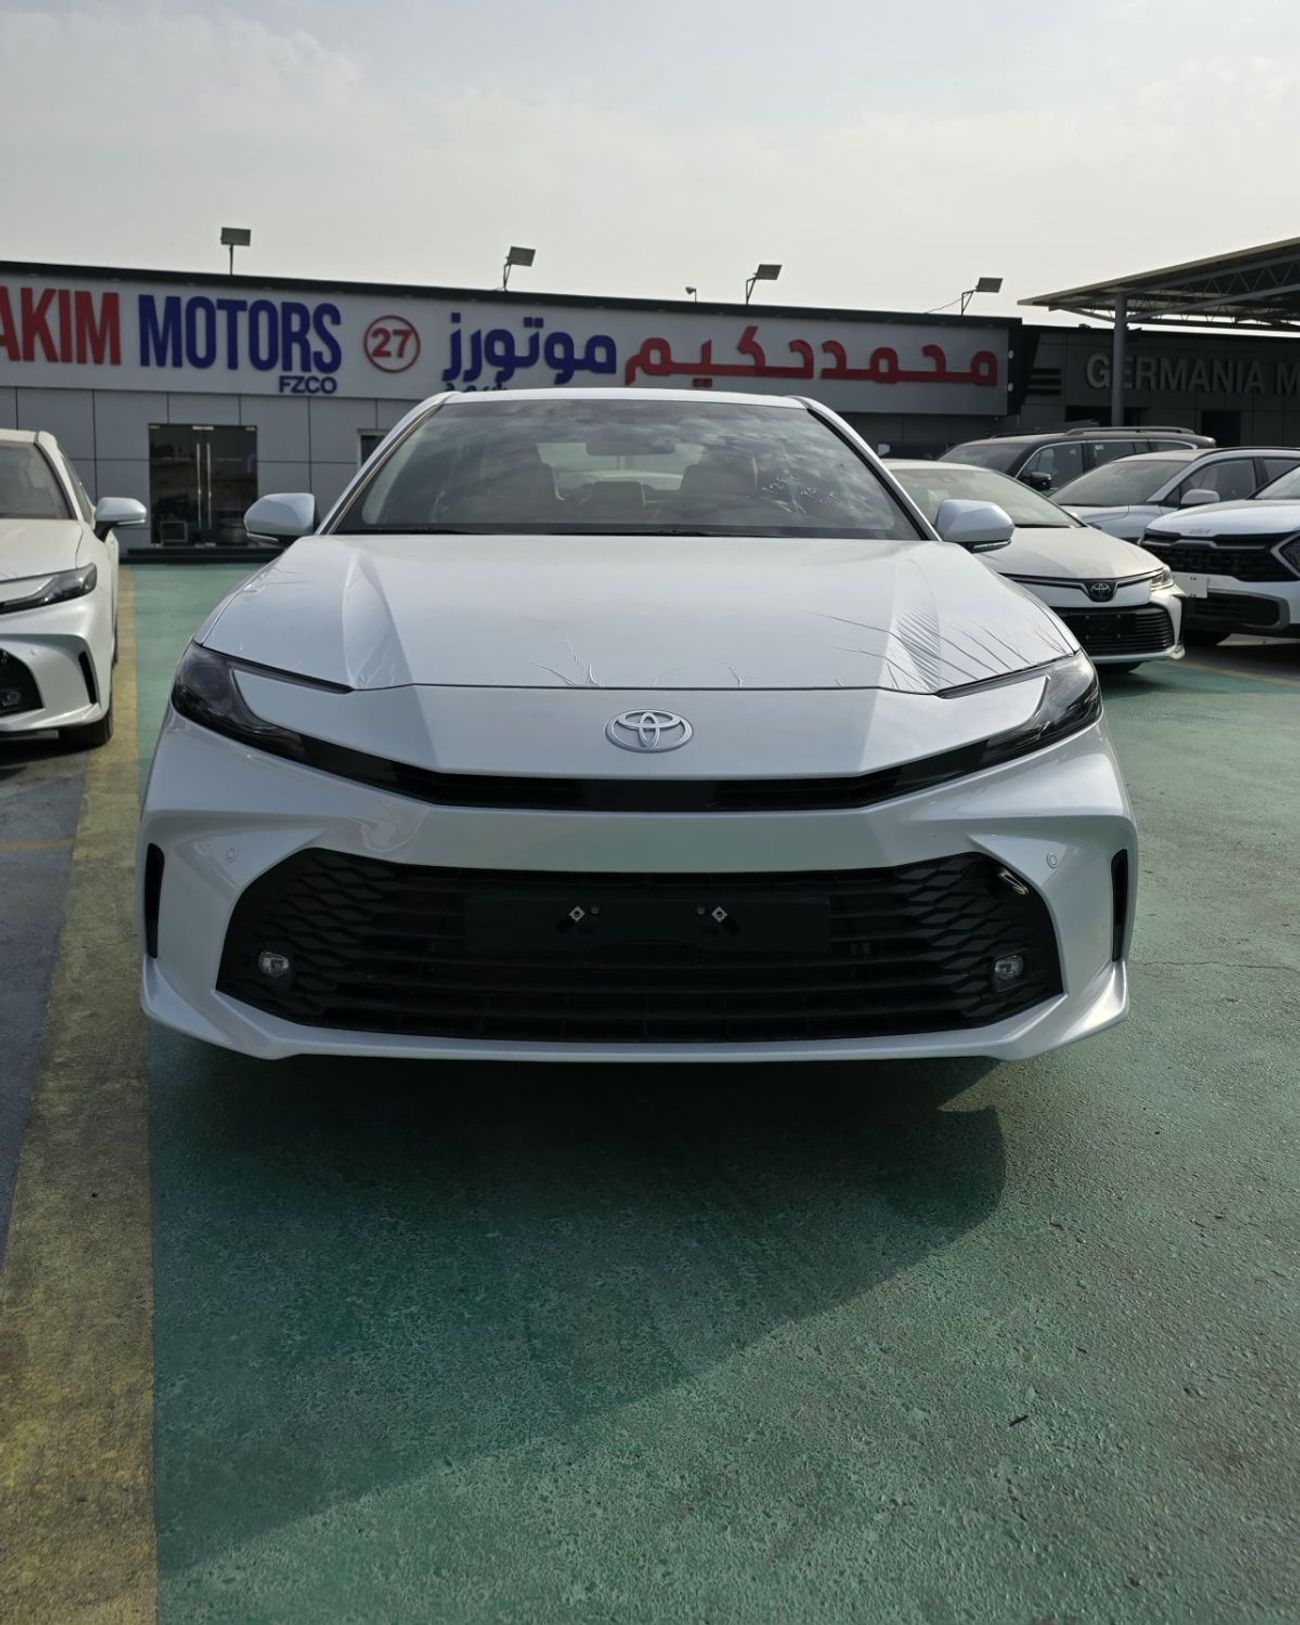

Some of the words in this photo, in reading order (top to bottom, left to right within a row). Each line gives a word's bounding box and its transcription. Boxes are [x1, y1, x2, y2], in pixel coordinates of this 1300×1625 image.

[139, 294, 342, 373] MOTORS
[371, 327, 412, 358] 27
[442, 311, 617, 385] موتورز
[625, 325, 814, 388] حكيم
[279, 375, 337, 394] FZCO
[820, 340, 998, 387] محمد
[1086, 353, 1265, 395] GERMANIA
